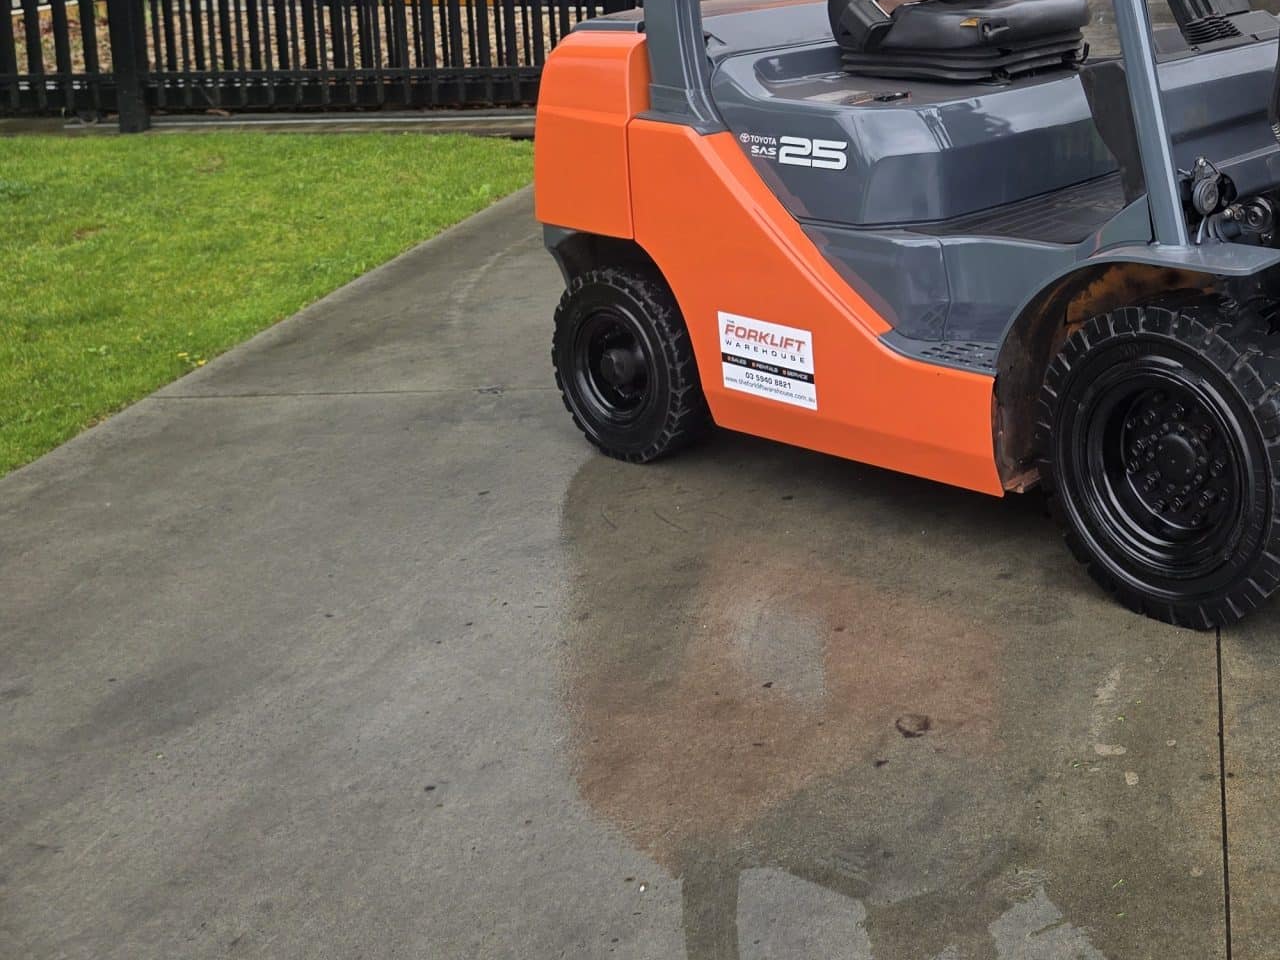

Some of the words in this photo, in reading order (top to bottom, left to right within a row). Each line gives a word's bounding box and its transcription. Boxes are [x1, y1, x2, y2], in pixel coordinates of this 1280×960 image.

[750, 135, 777, 146] TOYOTA
[751, 145, 777, 156] SAS
[778, 135, 849, 171] 25
[725, 324, 806, 353] FORKLIFT
[725, 339, 806, 364] WAREHOUSE
[745, 371, 754, 380] 03
